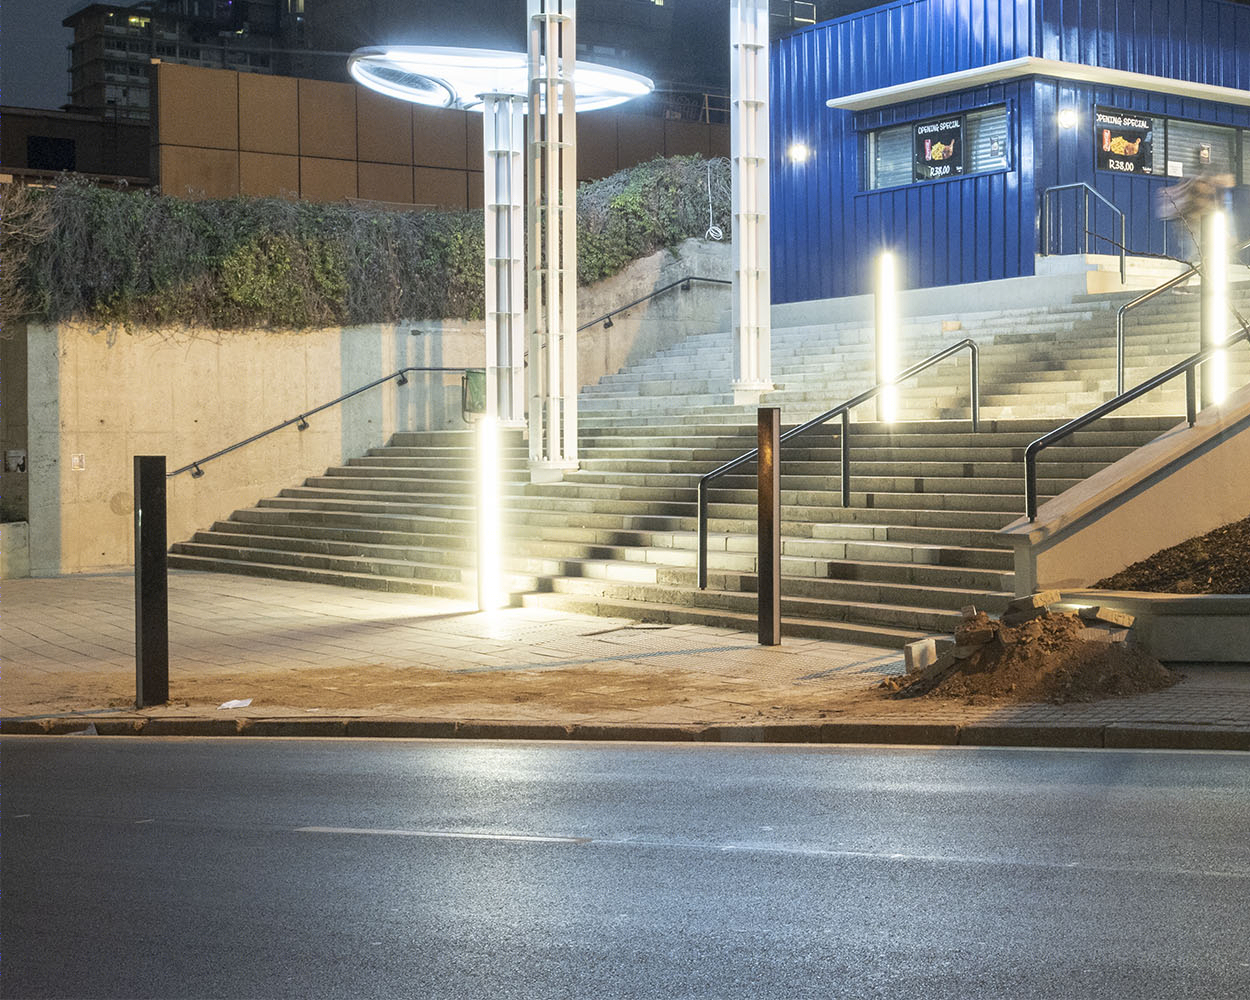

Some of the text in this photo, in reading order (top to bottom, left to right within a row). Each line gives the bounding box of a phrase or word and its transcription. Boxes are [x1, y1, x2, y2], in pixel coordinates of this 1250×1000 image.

[918, 120, 960, 134] OPENING SPECIAL
[1123, 117, 1149, 129] SPECIAL
